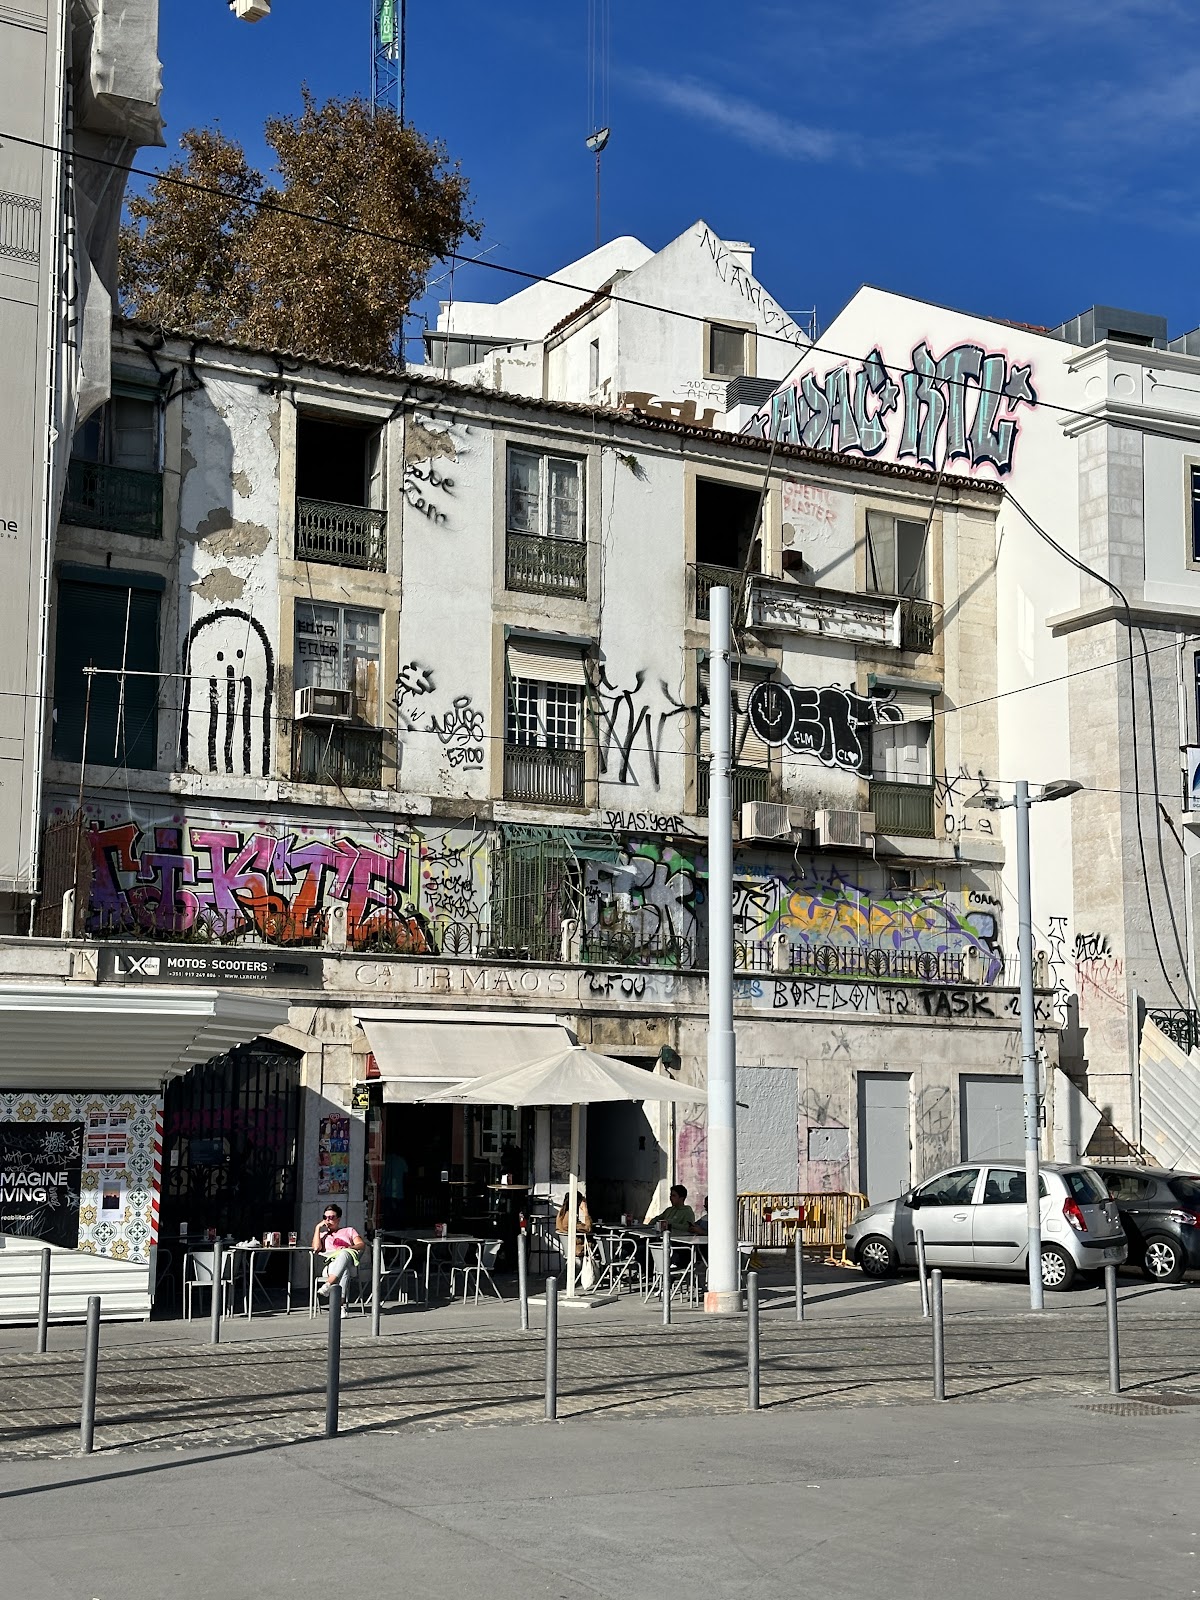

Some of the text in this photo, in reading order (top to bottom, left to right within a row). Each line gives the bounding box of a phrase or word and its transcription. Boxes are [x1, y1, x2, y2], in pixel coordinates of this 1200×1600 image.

[167, 957, 207, 969] MOTOS
[211, 959, 268, 972] SCOOTERS
[917, 990, 995, 1018] TASK
